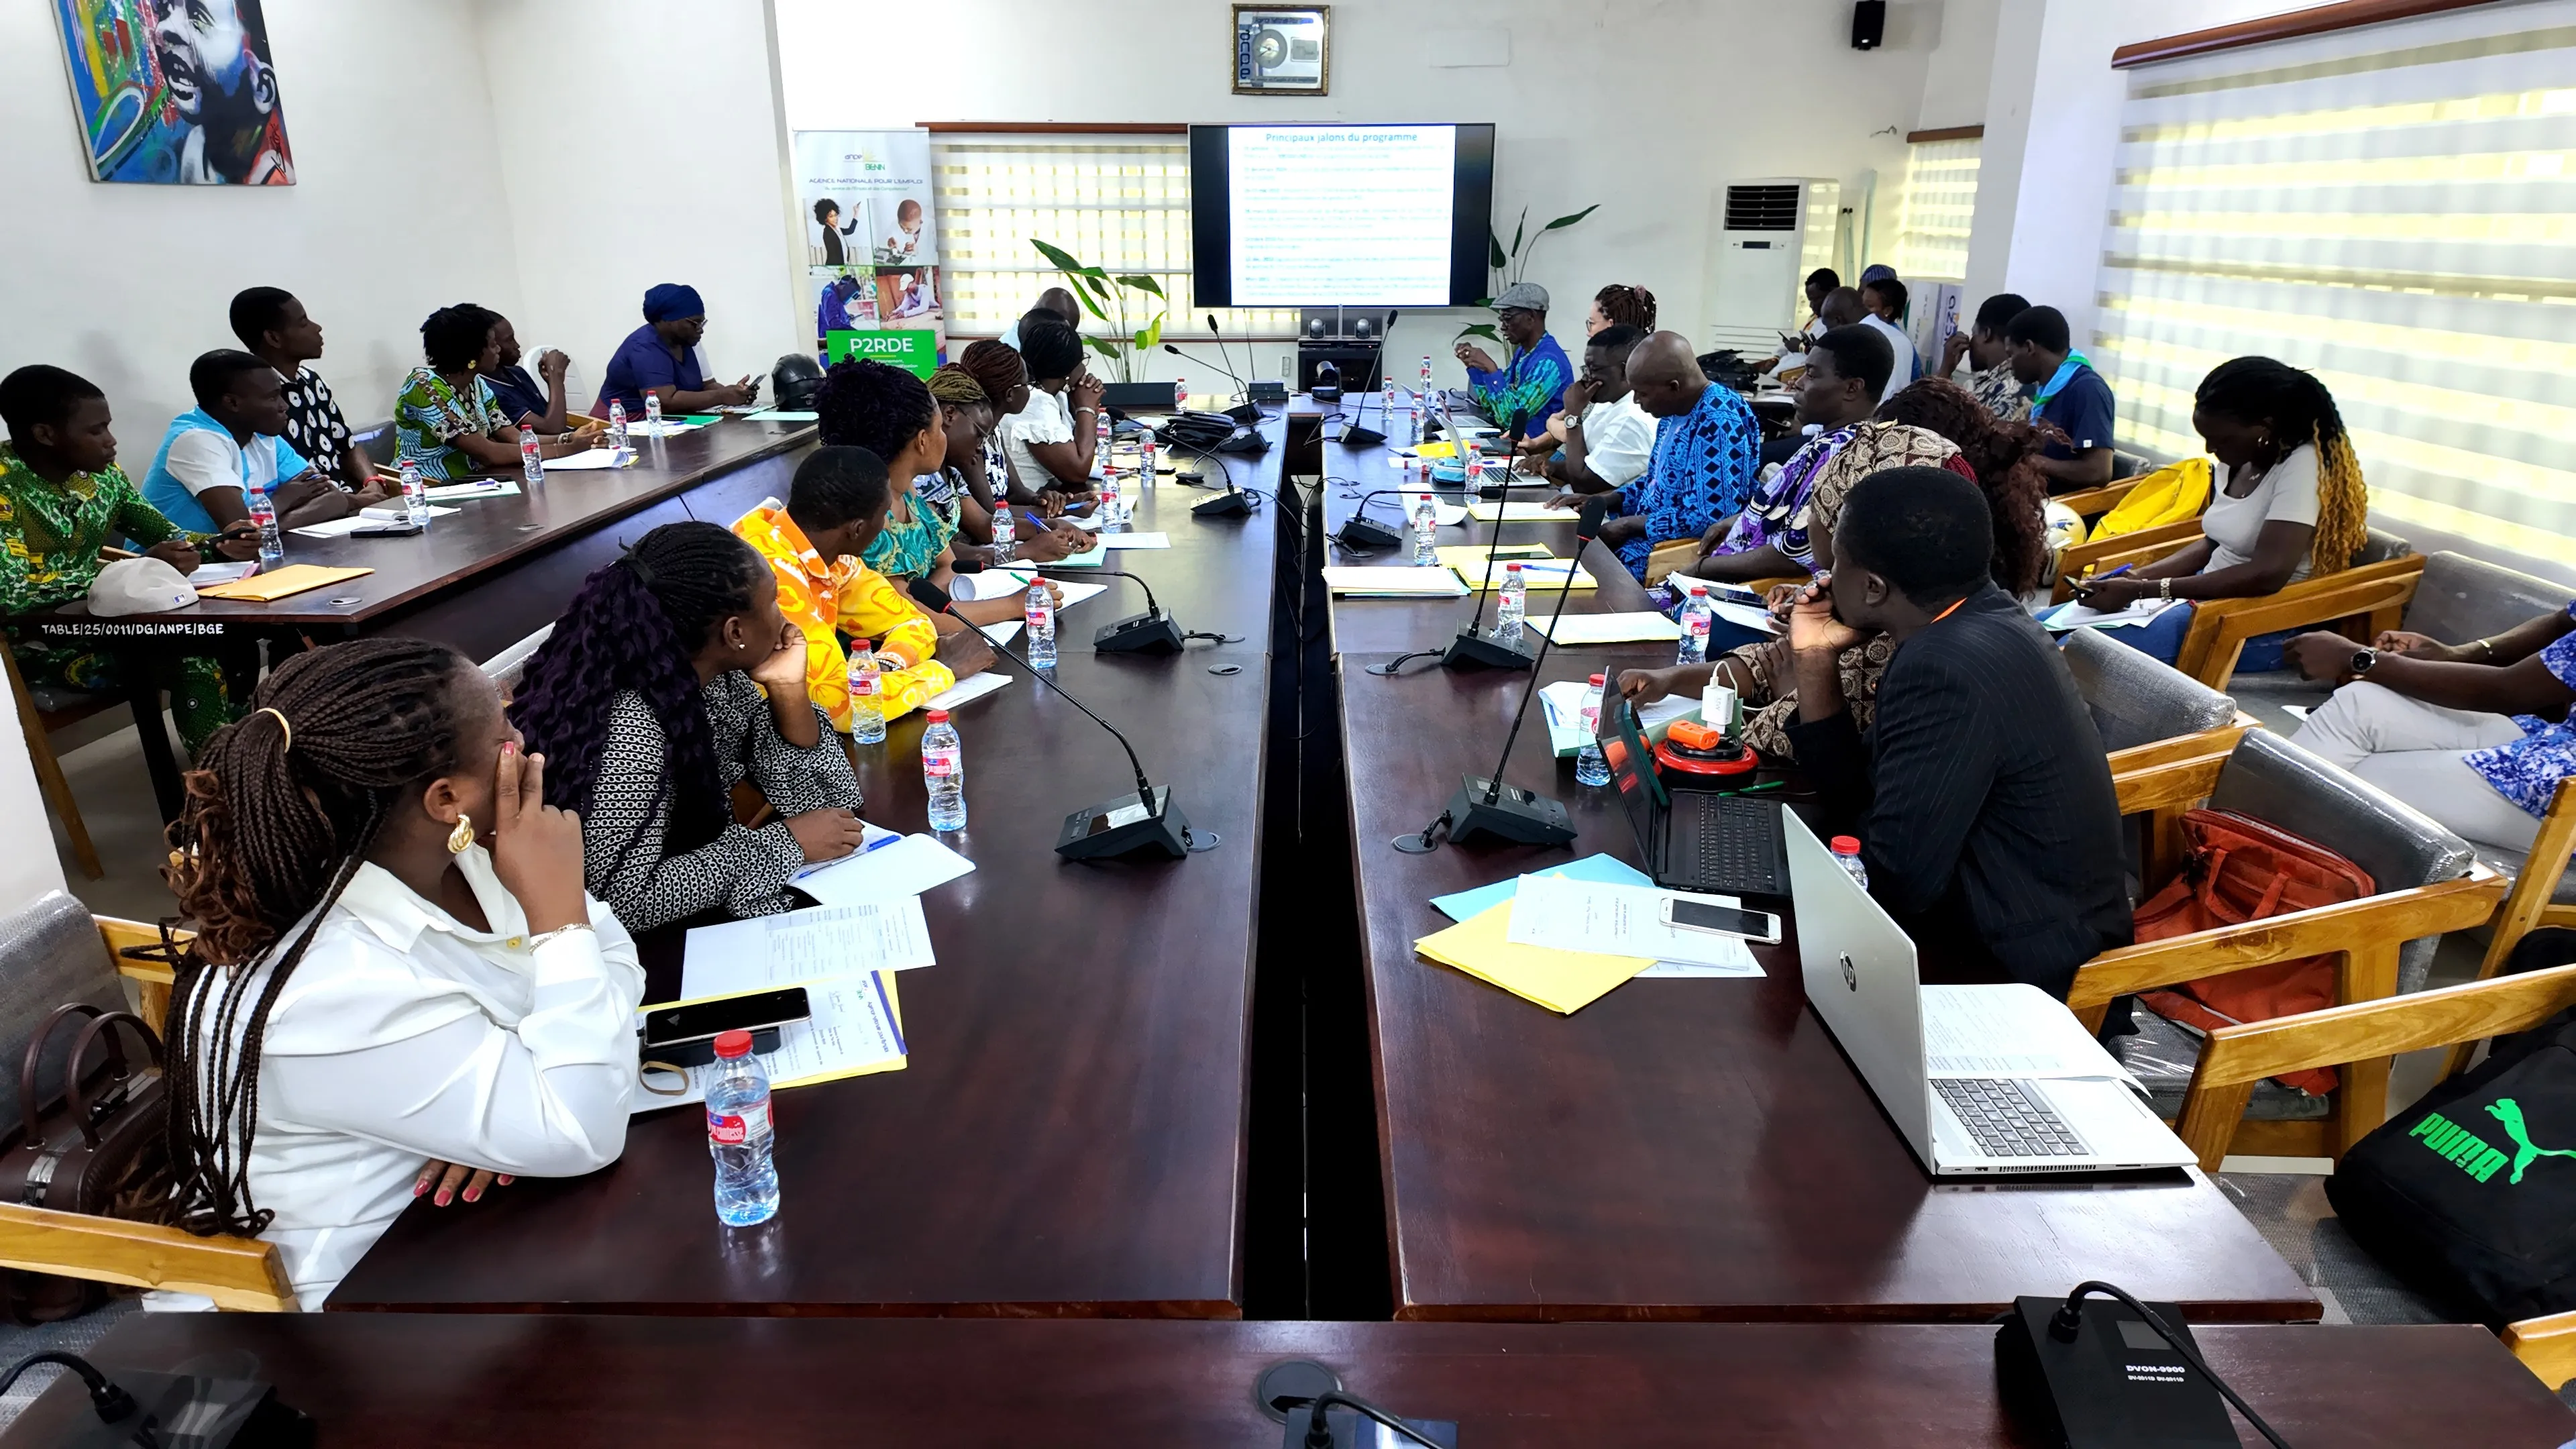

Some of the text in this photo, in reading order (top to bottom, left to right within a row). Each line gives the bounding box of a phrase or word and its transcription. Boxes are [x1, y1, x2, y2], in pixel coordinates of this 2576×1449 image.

[1266, 133, 1417, 143] Principaux jalons du programme
[850, 337, 914, 353] P2RDE
